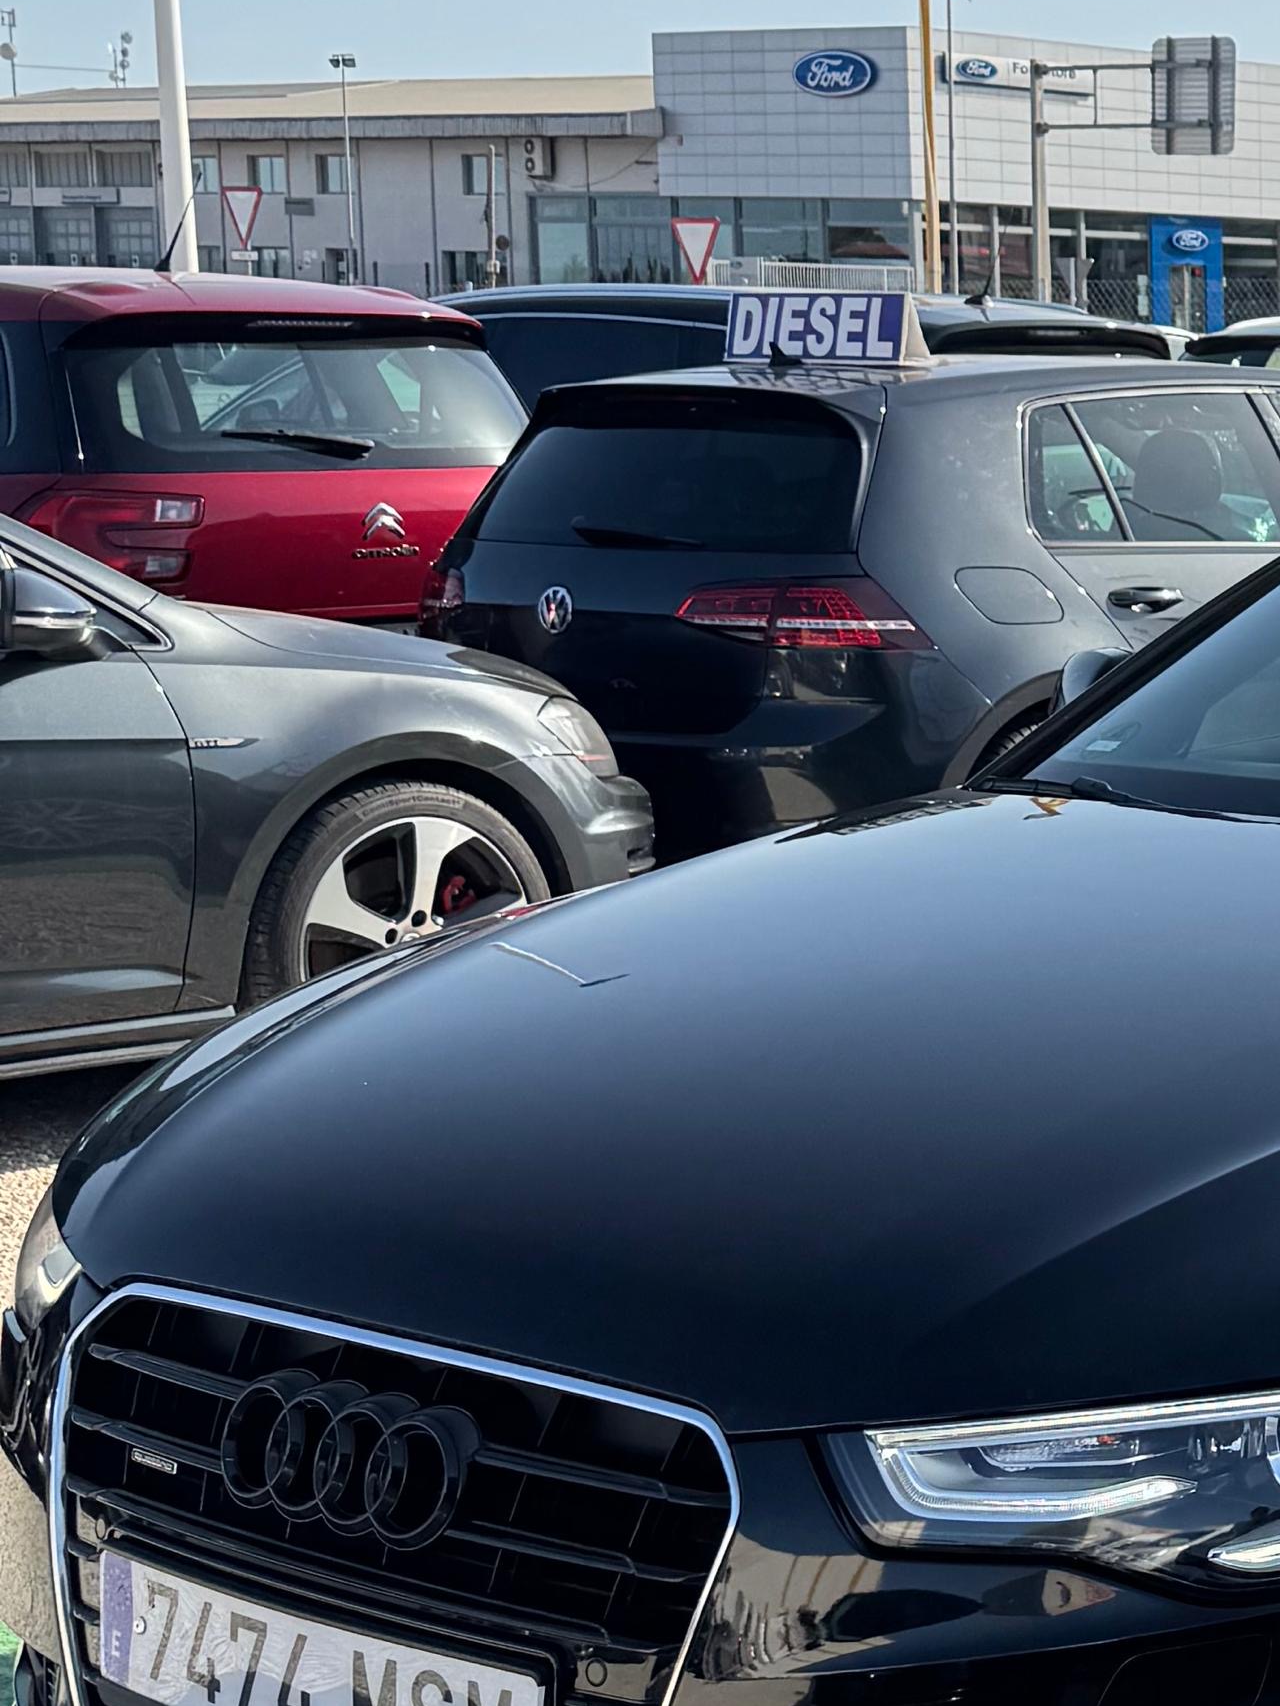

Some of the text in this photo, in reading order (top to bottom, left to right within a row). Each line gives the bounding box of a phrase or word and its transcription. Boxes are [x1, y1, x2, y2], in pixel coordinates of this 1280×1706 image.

[807, 58, 854, 87] Ford
[732, 296, 894, 358] DIESEL
[111, 1629, 122, 1658] E
